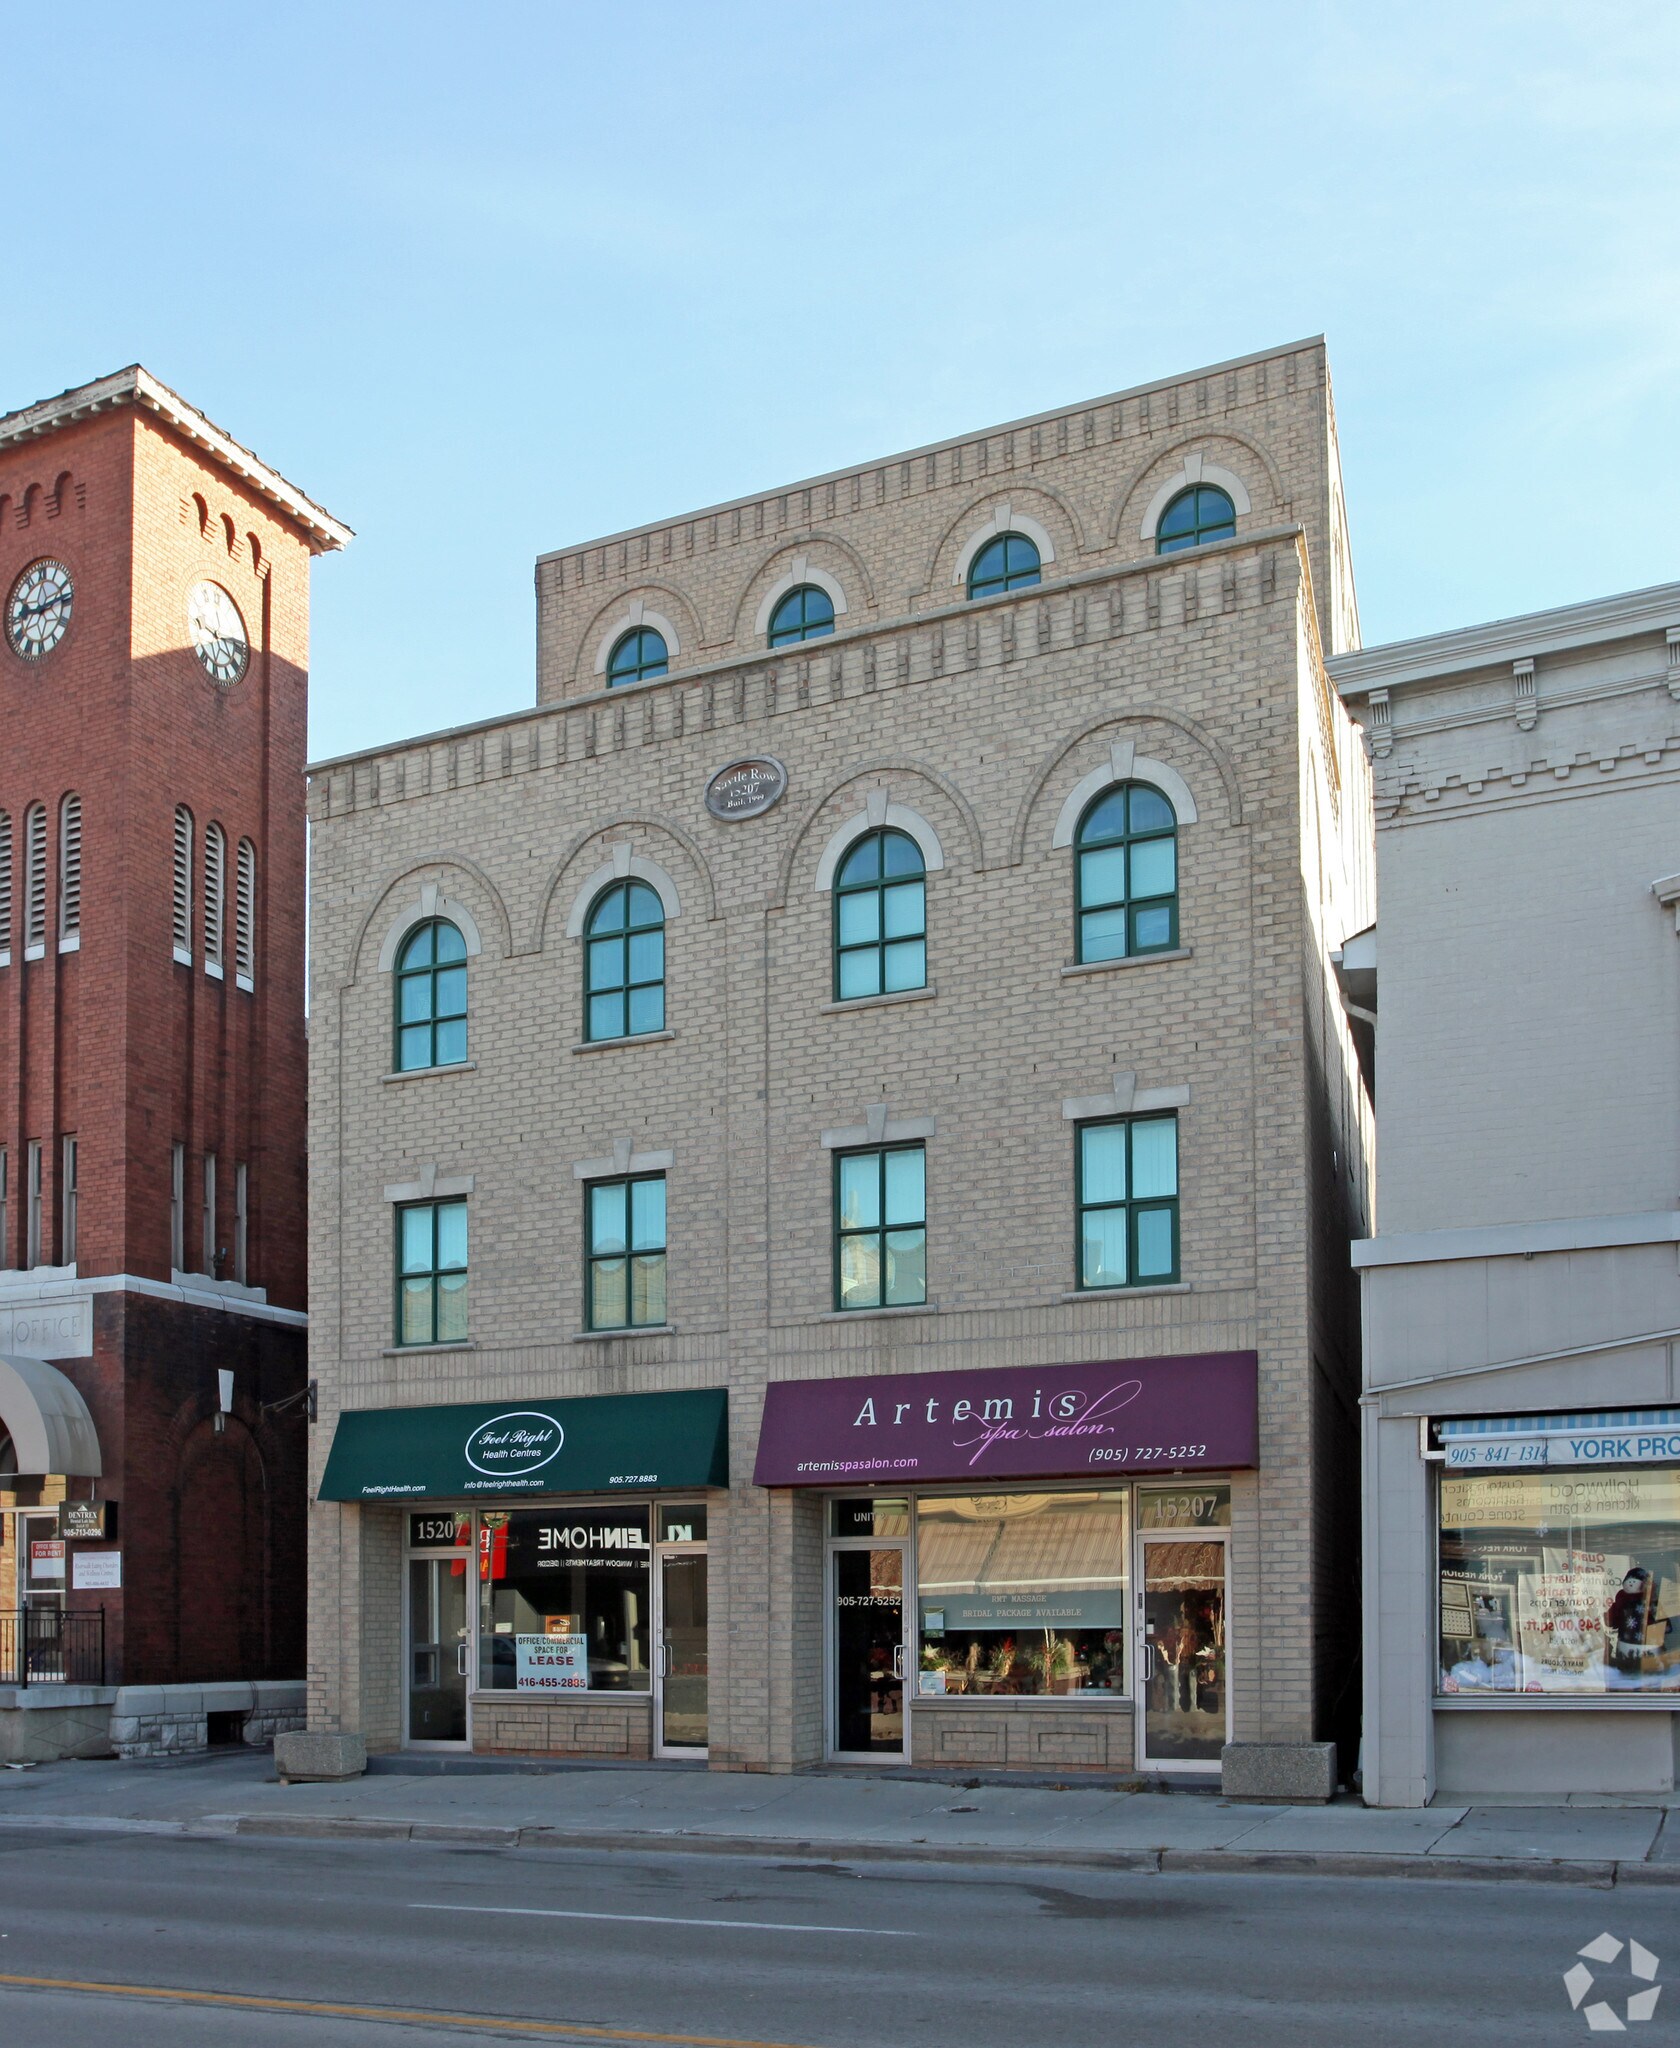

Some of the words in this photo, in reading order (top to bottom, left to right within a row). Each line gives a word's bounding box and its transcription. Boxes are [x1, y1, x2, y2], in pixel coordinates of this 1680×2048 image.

[750, 768, 776, 782] Row
[15, 1315, 81, 1343] OFFICE
[853, 1389, 1077, 1426] Artemis
[479, 1431, 510, 1445] Feel
[510, 1429, 553, 1448] Right
[482, 1450, 508, 1459] Health
[510, 1449, 541, 1458] Centres
[1088, 1447, 1129, 1463] (905)
[1135, 1444, 1206, 1461] 727-5252
[1451, 1445, 1549, 1463] 905-841-1314
[1570, 1439, 1632, 1459] YORK
[797, 1456, 918, 1472] artemisspasalon.com
[609, 1474, 658, 1484] 905.727.8883
[362, 1485, 426, 1494] FeelRightHealth.com
[1154, 1496, 1217, 1519] 15207
[68, 1511, 97, 1519] DENTREX
[853, 1512, 876, 1522] UNIT
[418, 1521, 463, 1540] 15207
[837, 1596, 901, 1606] 905-727-5252
[991, 1595, 1008, 1603] RMT
[1011, 1595, 1047, 1603] MASSAGE
[962, 1609, 993, 1618] BRIDAL
[996, 1609, 1032, 1617] PACKAGE
[1036, 1608, 1082, 1617] AVAILABLE
[534, 1646, 554, 1654] SPACE
[555, 1646, 568, 1654] FOR
[528, 1656, 574, 1666] LEASE
